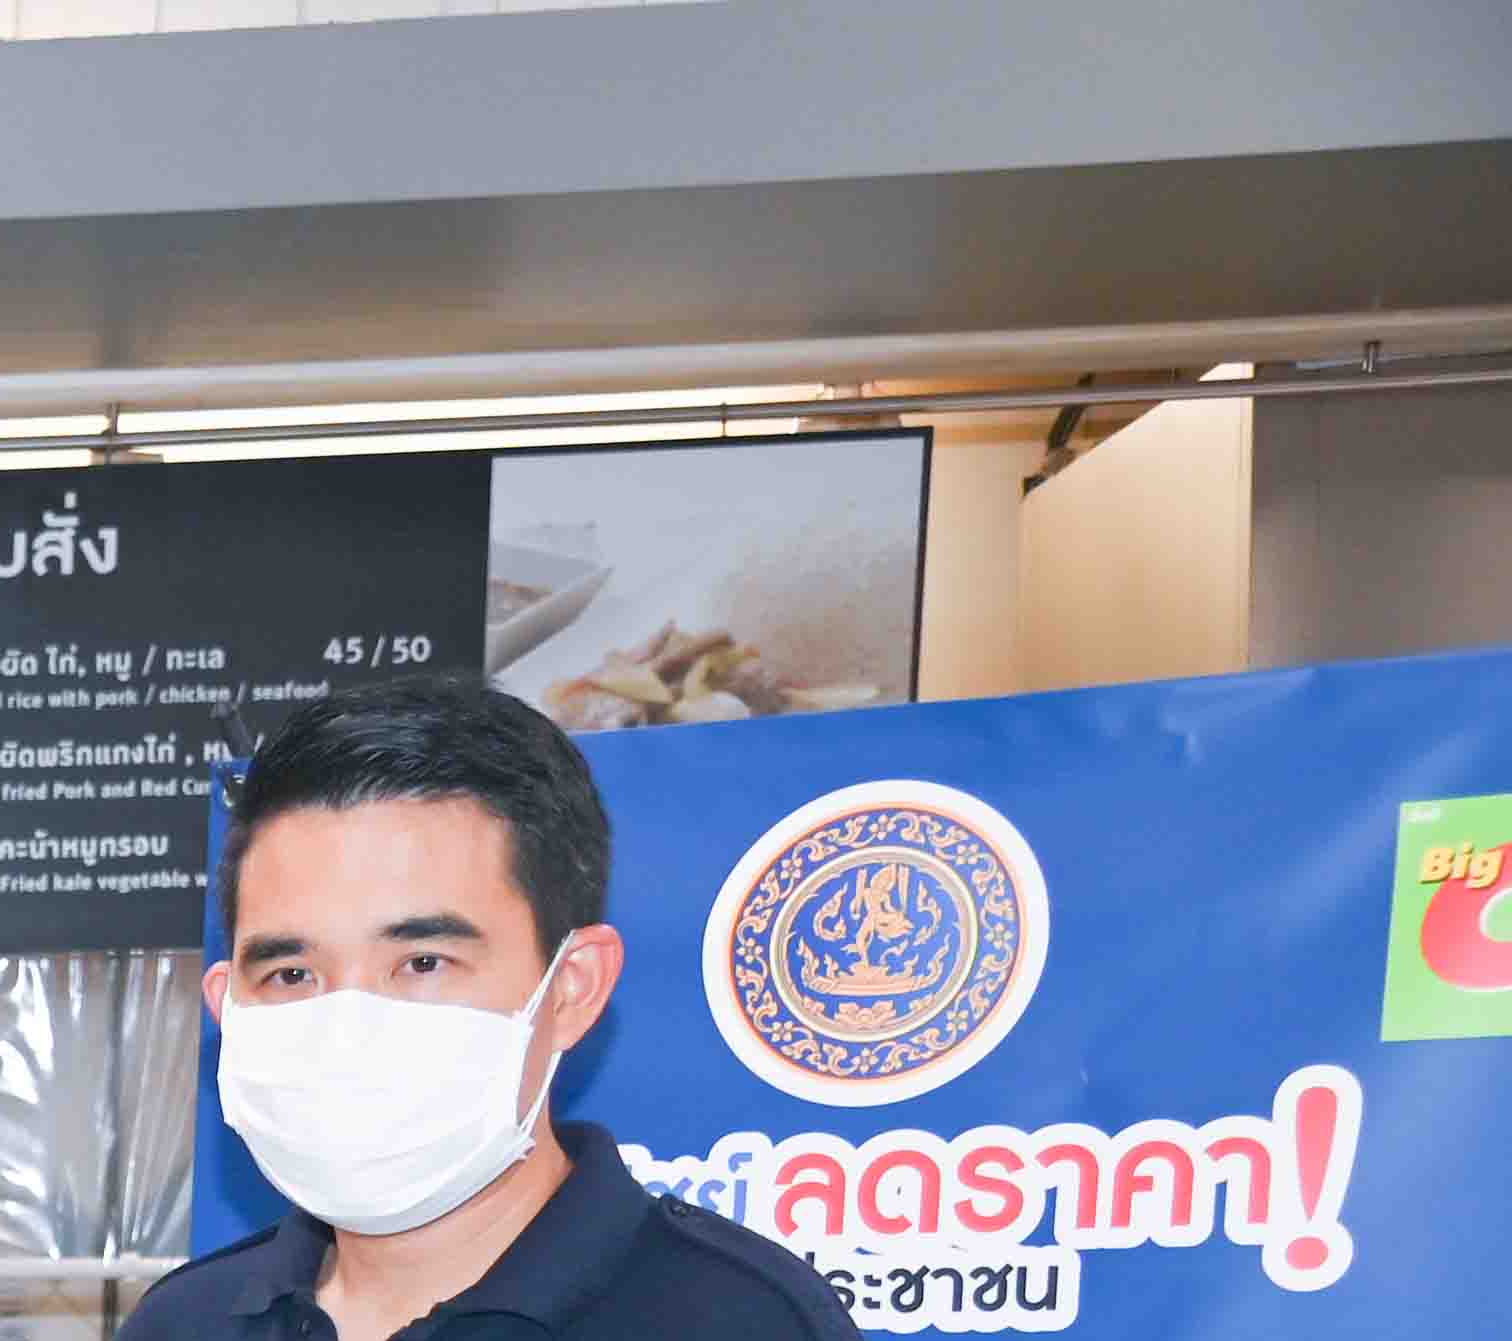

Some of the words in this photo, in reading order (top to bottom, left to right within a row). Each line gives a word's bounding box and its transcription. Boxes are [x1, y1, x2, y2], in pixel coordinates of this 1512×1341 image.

[96, 653, 131, 681] หมู
[166, 647, 224, 669] ทะเล
[7, 691, 41, 709] rice
[47, 690, 89, 707] with
[96, 690, 137, 709] pork
[159, 685, 230, 704] chicken
[53, 782, 96, 799] Pork
[101, 782, 135, 798] and
[141, 780, 177, 797] Red
[1419, 842, 1503, 889] Big
[0, 875, 49, 893] Fried
[53, 873, 92, 890] kale
